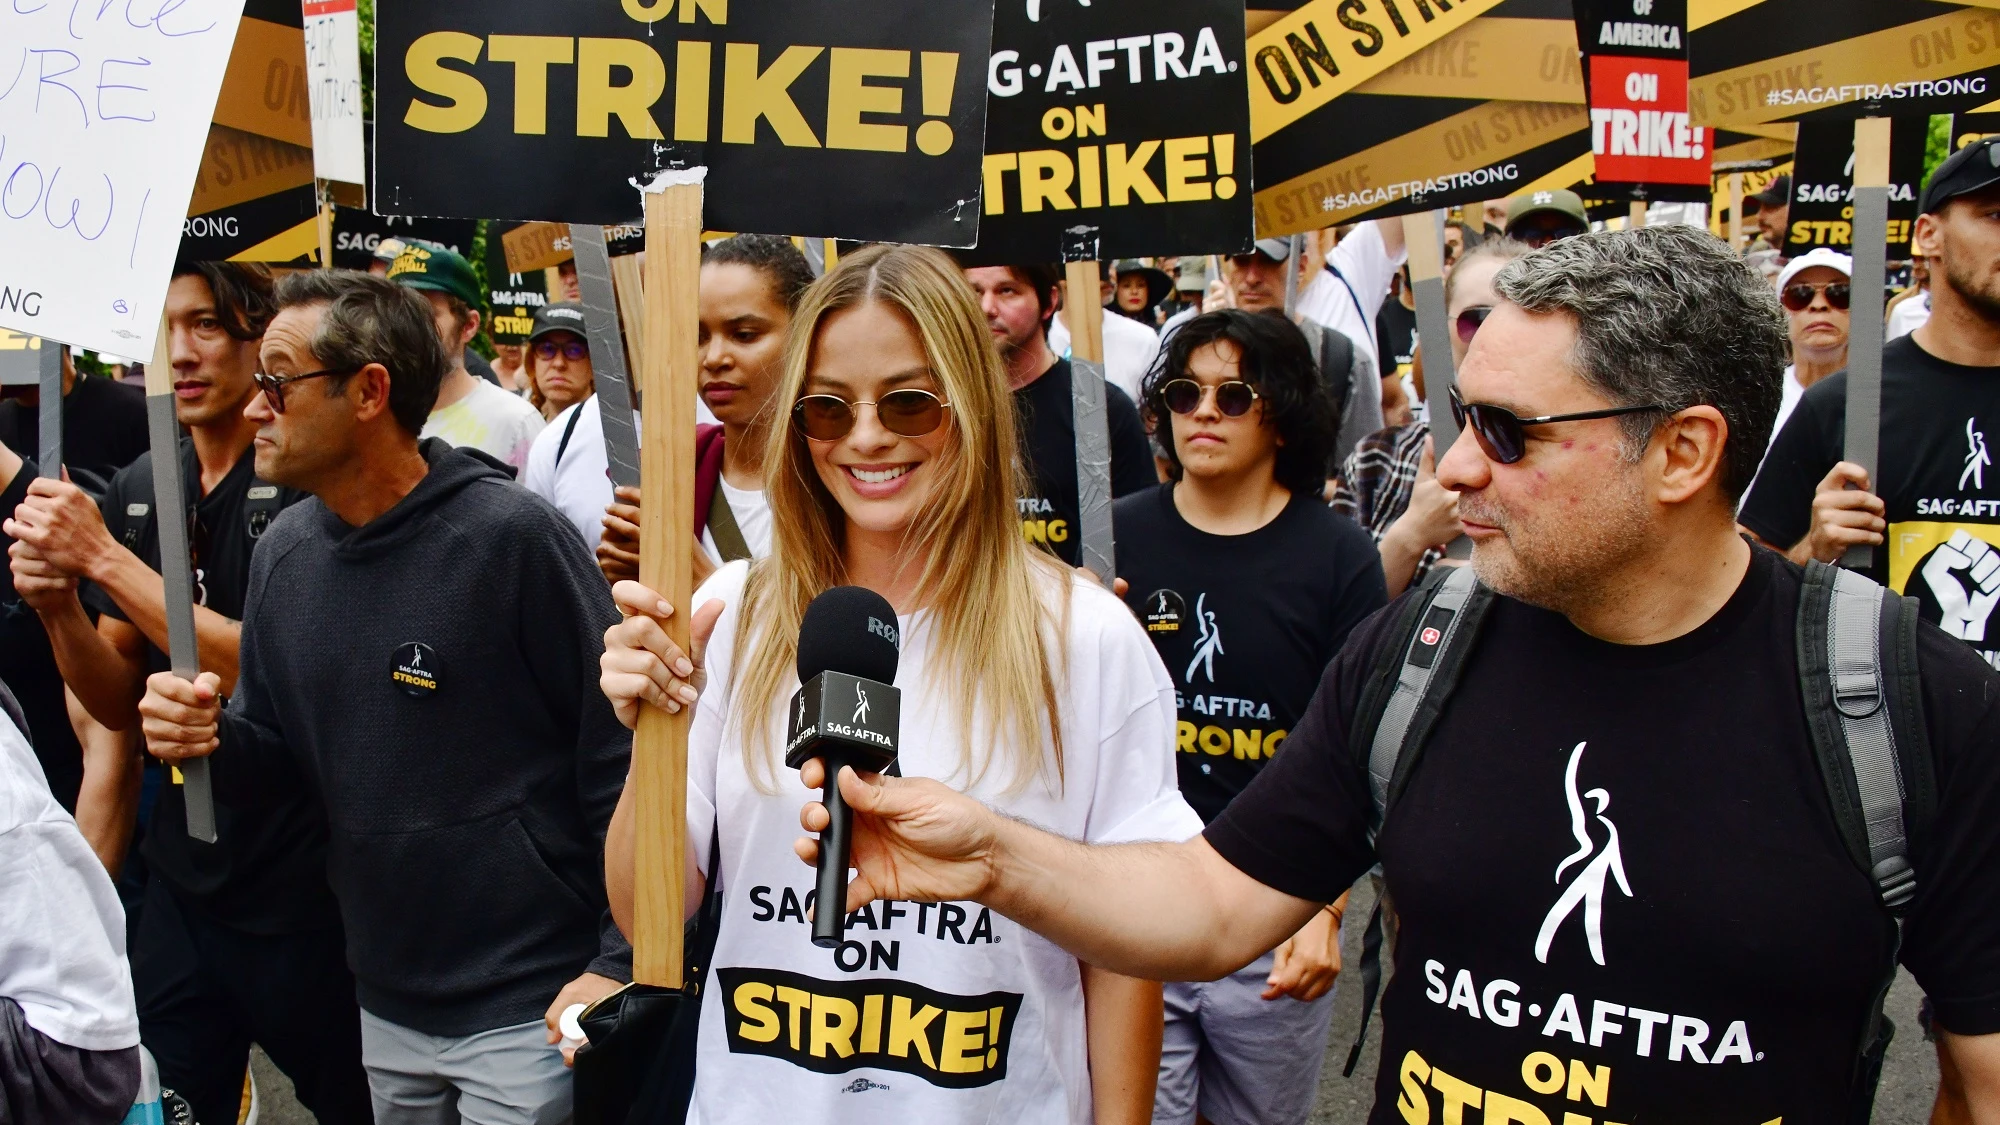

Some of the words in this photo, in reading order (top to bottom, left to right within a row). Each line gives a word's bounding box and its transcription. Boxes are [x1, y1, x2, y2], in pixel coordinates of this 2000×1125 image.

[1599, 21, 1682, 49] AMERICA
[1909, 26, 1957, 69] ON
[1254, 21, 1340, 104] ON
[403, 31, 960, 156] STRIKE!
[1625, 72, 1658, 102] ON
[1767, 77, 1986, 106] #SAGAFTRASTRONG
[1041, 104, 1106, 140] ON
[1443, 118, 1487, 162] ON
[1591, 108, 1704, 160] TRIKE!
[982, 133, 1237, 215] TRIKE!
[1322, 164, 1518, 212] #SAGAFTRASTRONG
[1916, 498, 2000, 517] SAG·AFT
[868, 616, 899, 650] RØ
[393, 671, 437, 689] STRONG
[834, 940, 900, 972] ON
[733, 982, 1004, 1073] STRIKE!
[1521, 1051, 1611, 1107] ON
